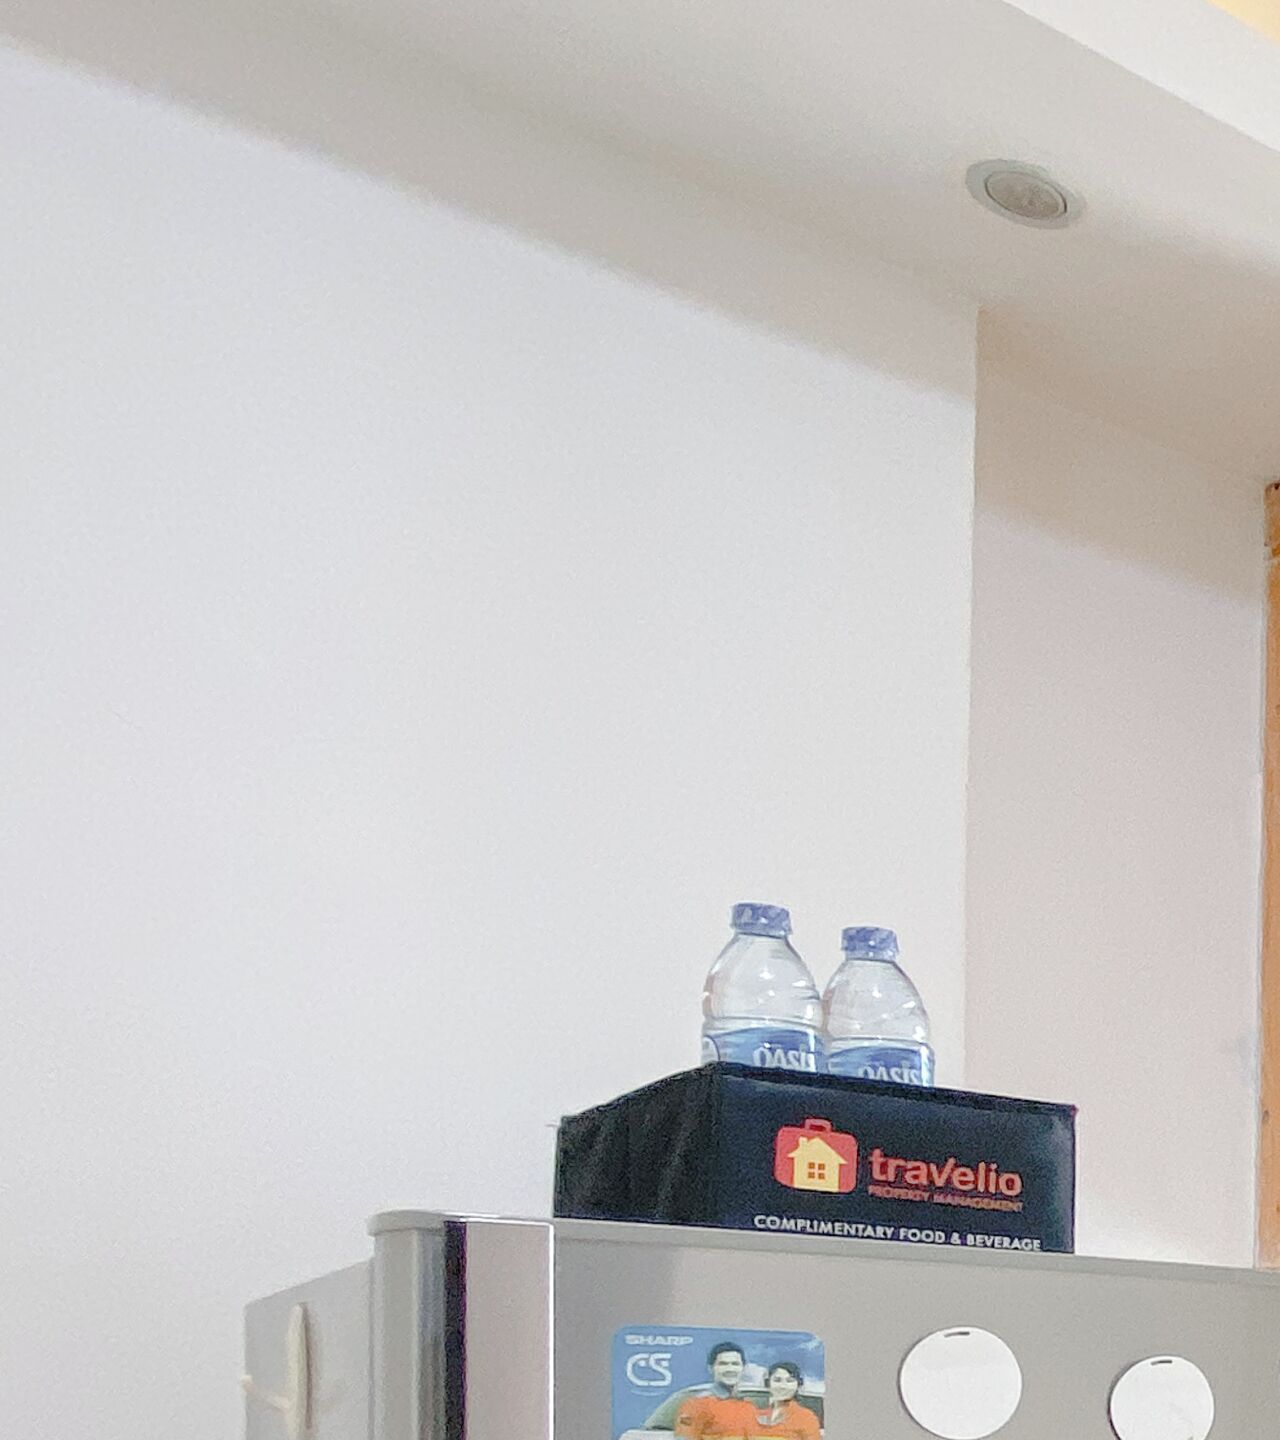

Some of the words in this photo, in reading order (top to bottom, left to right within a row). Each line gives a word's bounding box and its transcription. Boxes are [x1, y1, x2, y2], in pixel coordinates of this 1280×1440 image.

[869, 1149, 1023, 1197] travelio
[754, 1215, 894, 1239] COMPLIMENTARY
[900, 1228, 945, 1244] FOOD
[950, 1232, 962, 1245] &
[967, 1233, 1041, 1251] BEVERAGE
[624, 1335, 694, 1346] SHARP
